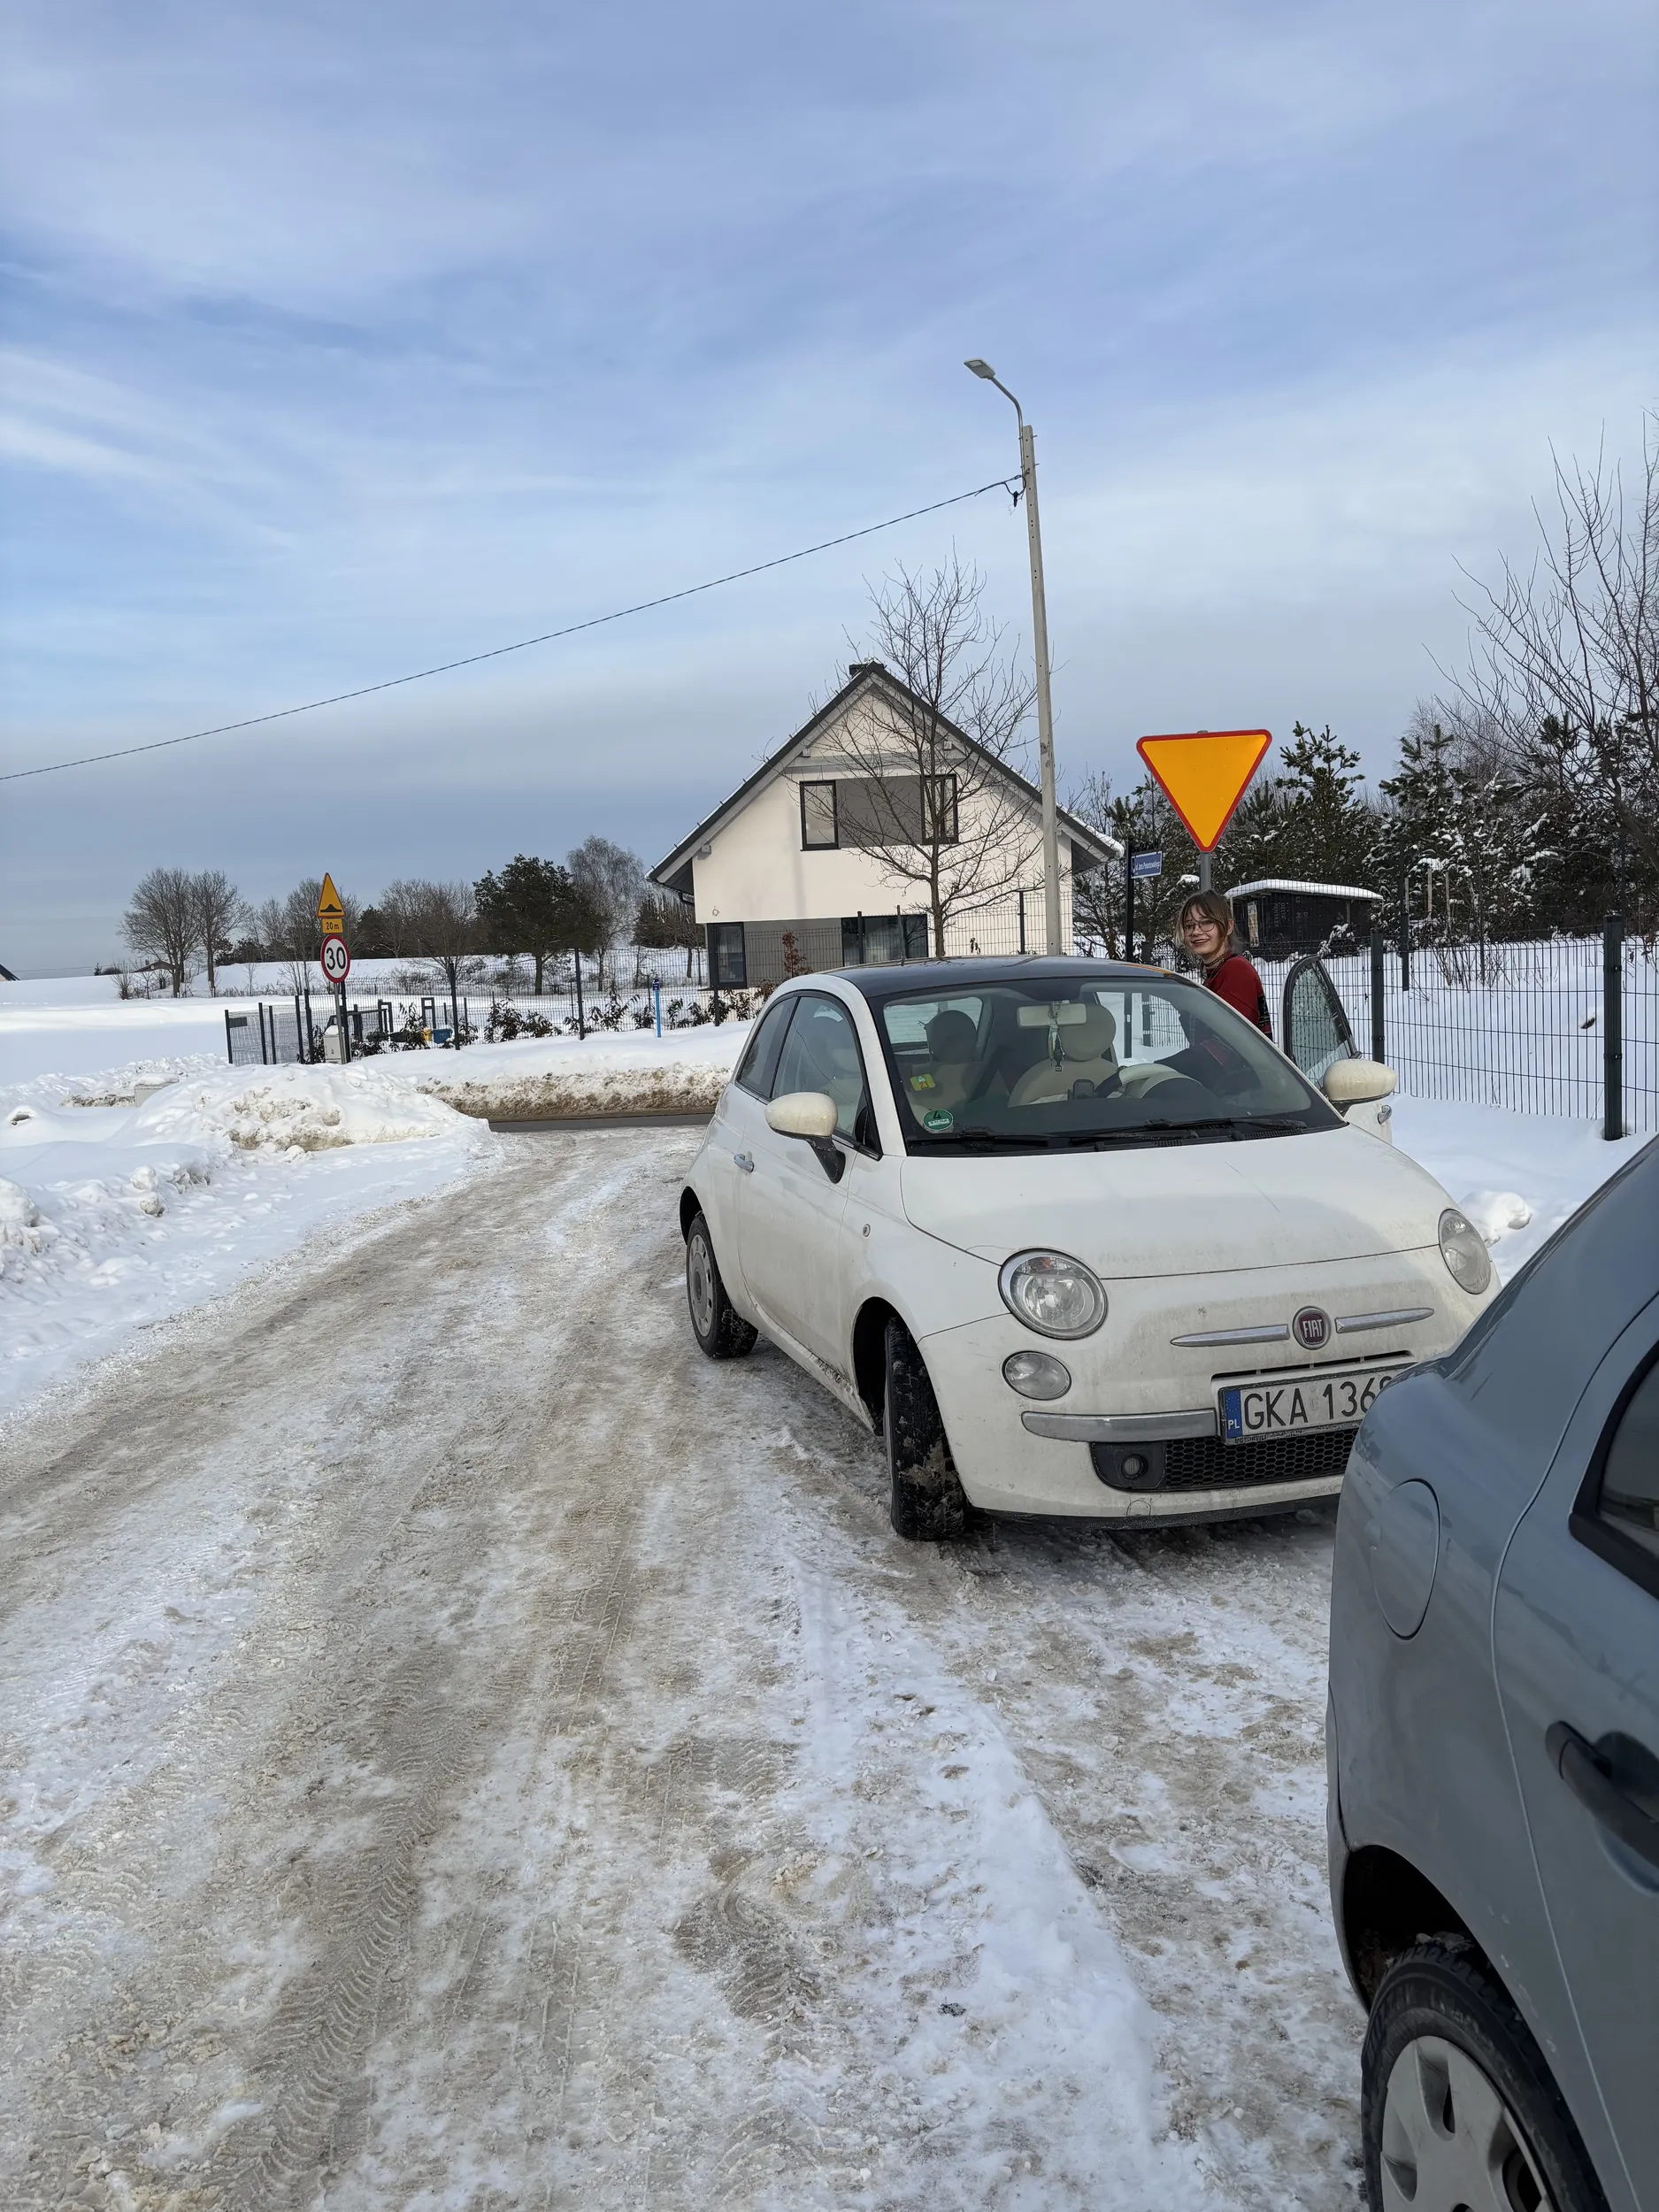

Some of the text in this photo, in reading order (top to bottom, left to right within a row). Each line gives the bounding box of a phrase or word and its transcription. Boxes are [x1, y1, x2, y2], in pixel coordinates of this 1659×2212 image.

[326, 921, 334, 930] 20
[326, 946, 346, 971] 30
[933, 1110, 942, 1119] 4
[1302, 1318, 1324, 1339] FIAT
[1244, 1387, 1309, 1430] GKA
[1227, 1418, 1240, 1431] PL
